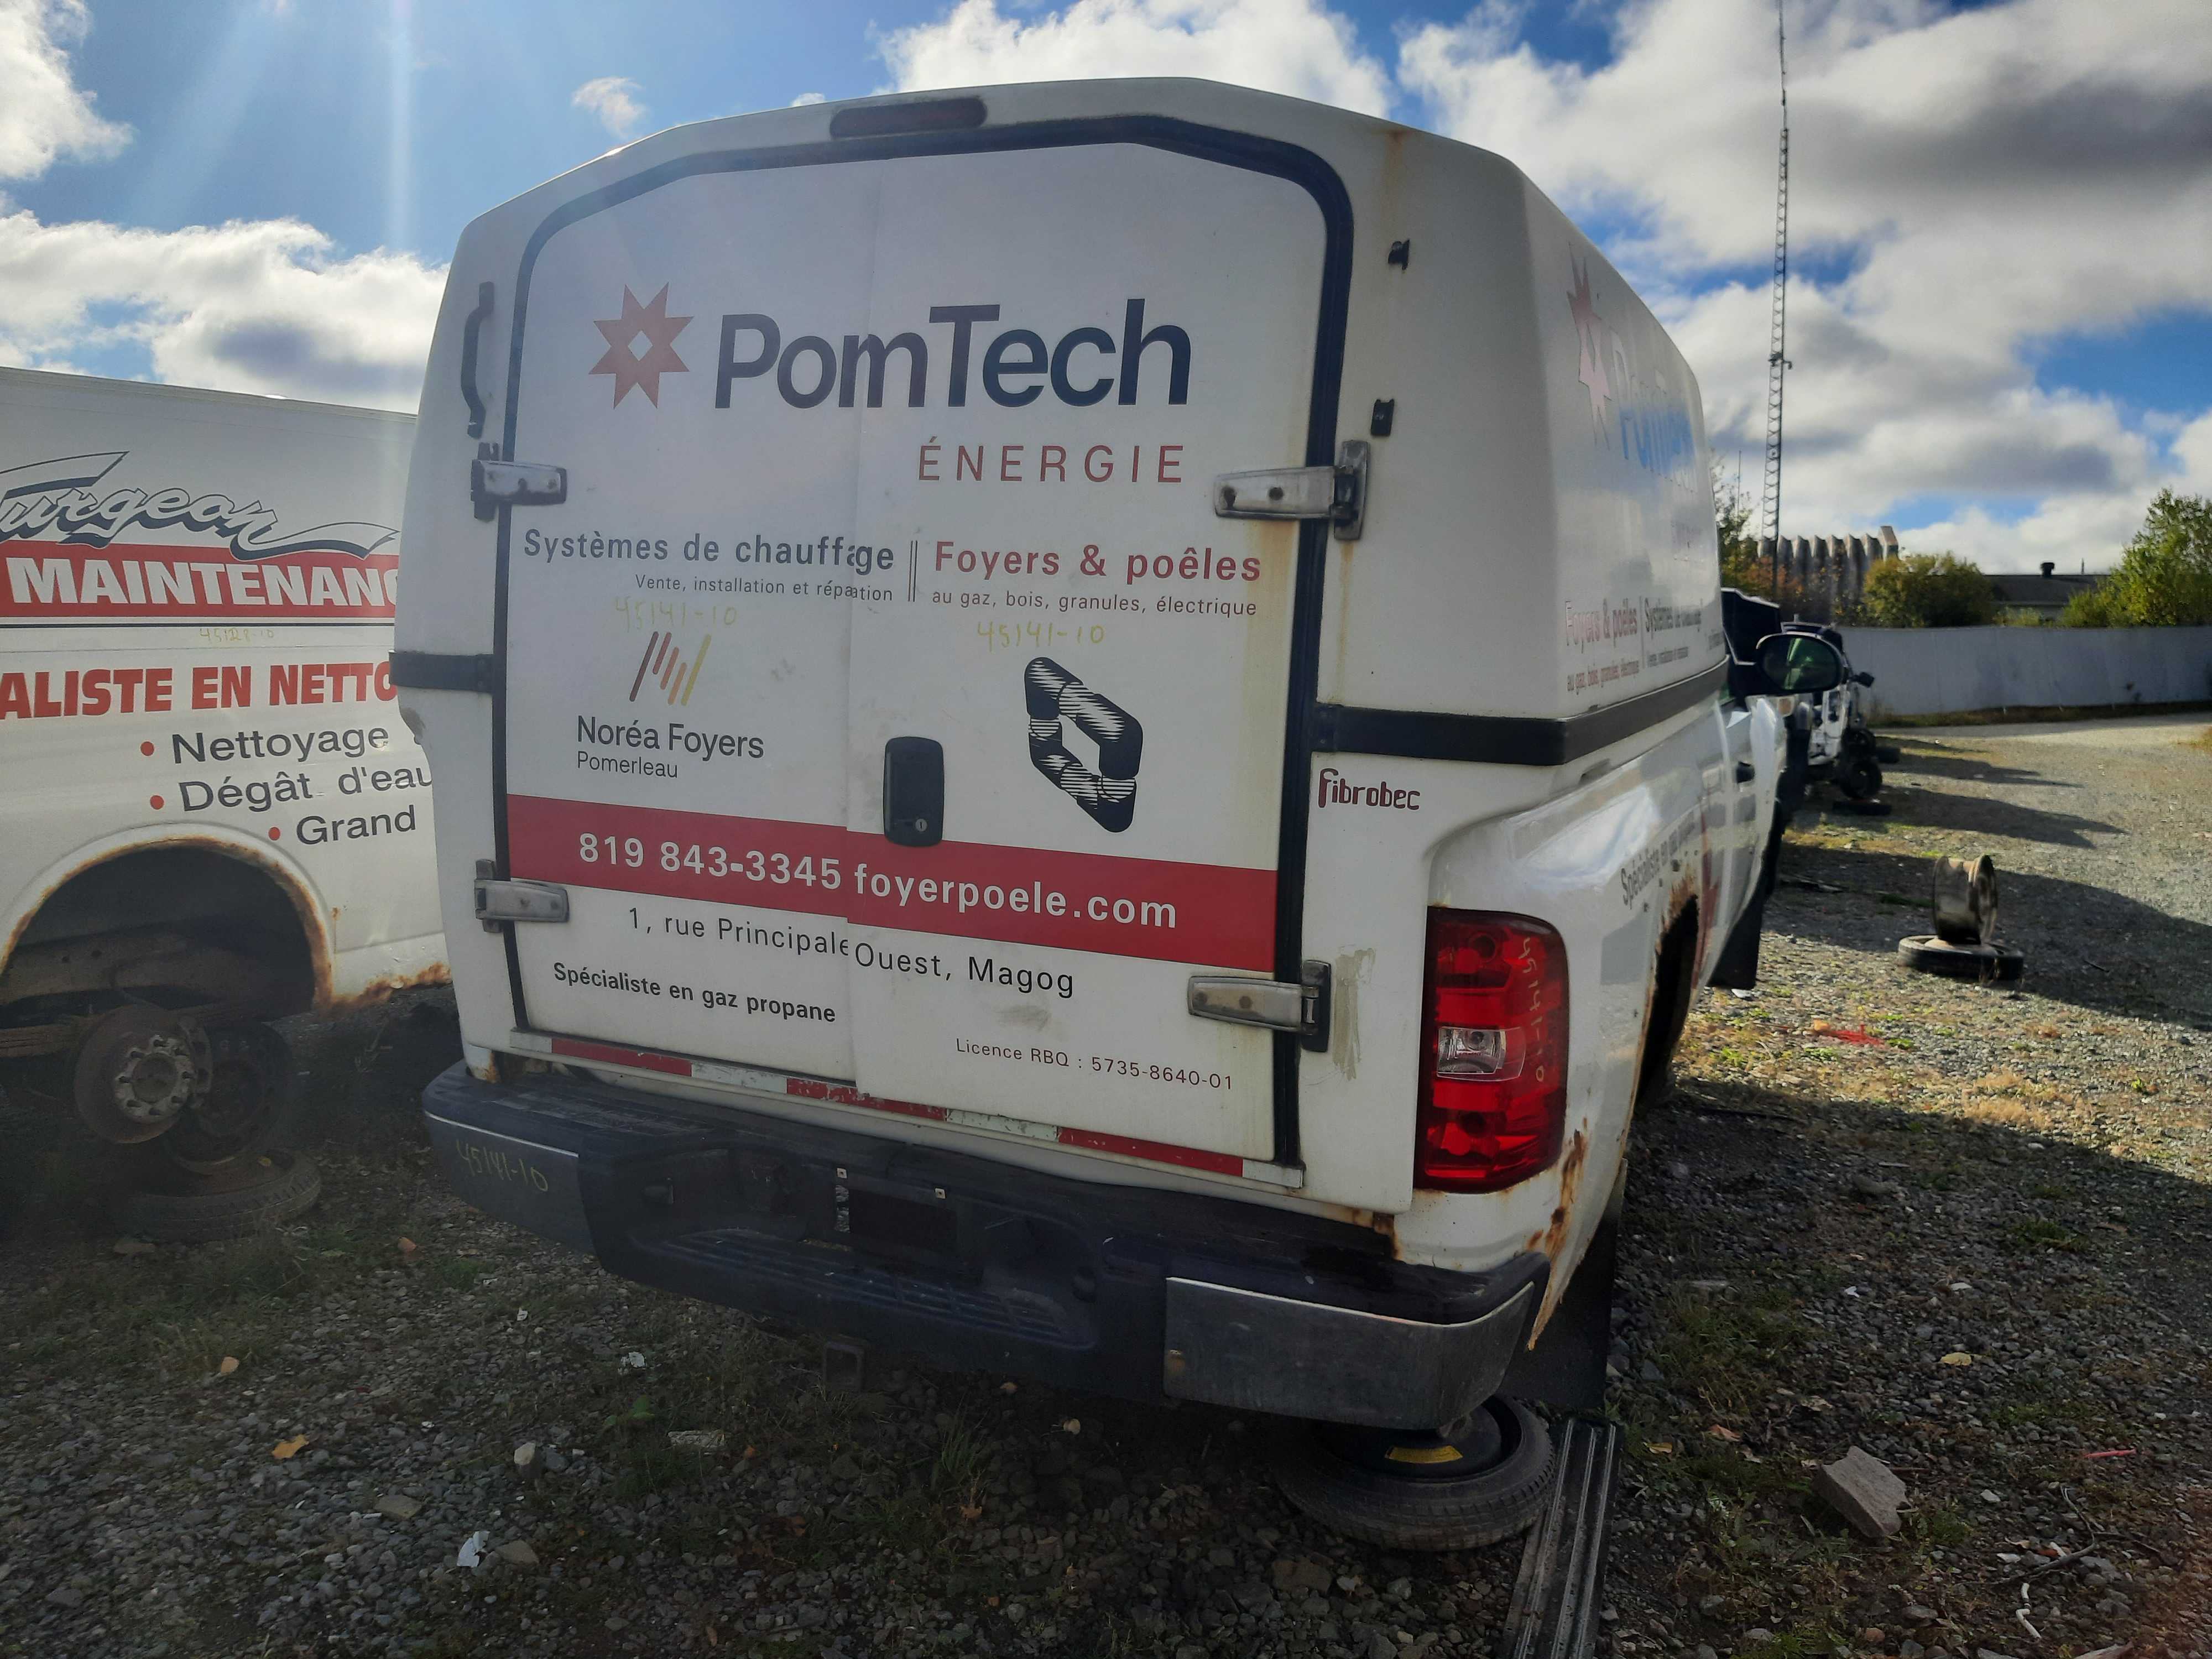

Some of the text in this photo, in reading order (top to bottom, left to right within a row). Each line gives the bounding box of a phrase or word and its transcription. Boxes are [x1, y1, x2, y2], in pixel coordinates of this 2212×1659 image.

[715, 299, 1191, 409] PomTech
[918, 436, 1183, 483] ÉNERGIE
[524, 529, 668, 563] Systèmes
[684, 534, 719, 562] de
[935, 541, 1261, 585] Foyers & poêles
[635, 575, 686, 592] Vente,
[694, 577, 785, 594] installation
[793, 582, 808, 595] et
[932, 589, 1257, 617] au gaz, bois, granules, électrique
[977, 622, 1105, 651] 45141-10
[192, 666, 252, 709] EN
[173, 727, 389, 764] Nettoyage
[577, 716, 764, 761] Noréa Foyers
[577, 751, 678, 779] Pomerleau
[178, 766, 432, 812] Dégât d'eau
[296, 805, 416, 845] Grand
[579, 832, 1177, 928] 819 843-3345 foyerpoele.com
[629, 907, 1074, 998] 1, rue Principale Ouest, Magog
[554, 963, 836, 1022] Spécialiste en gaz propane
[957, 1039, 1022, 1060] Licence
[1031, 1048, 1069, 1067] RBQ
[1092, 1057, 1232, 1089] 5735-8640-01
